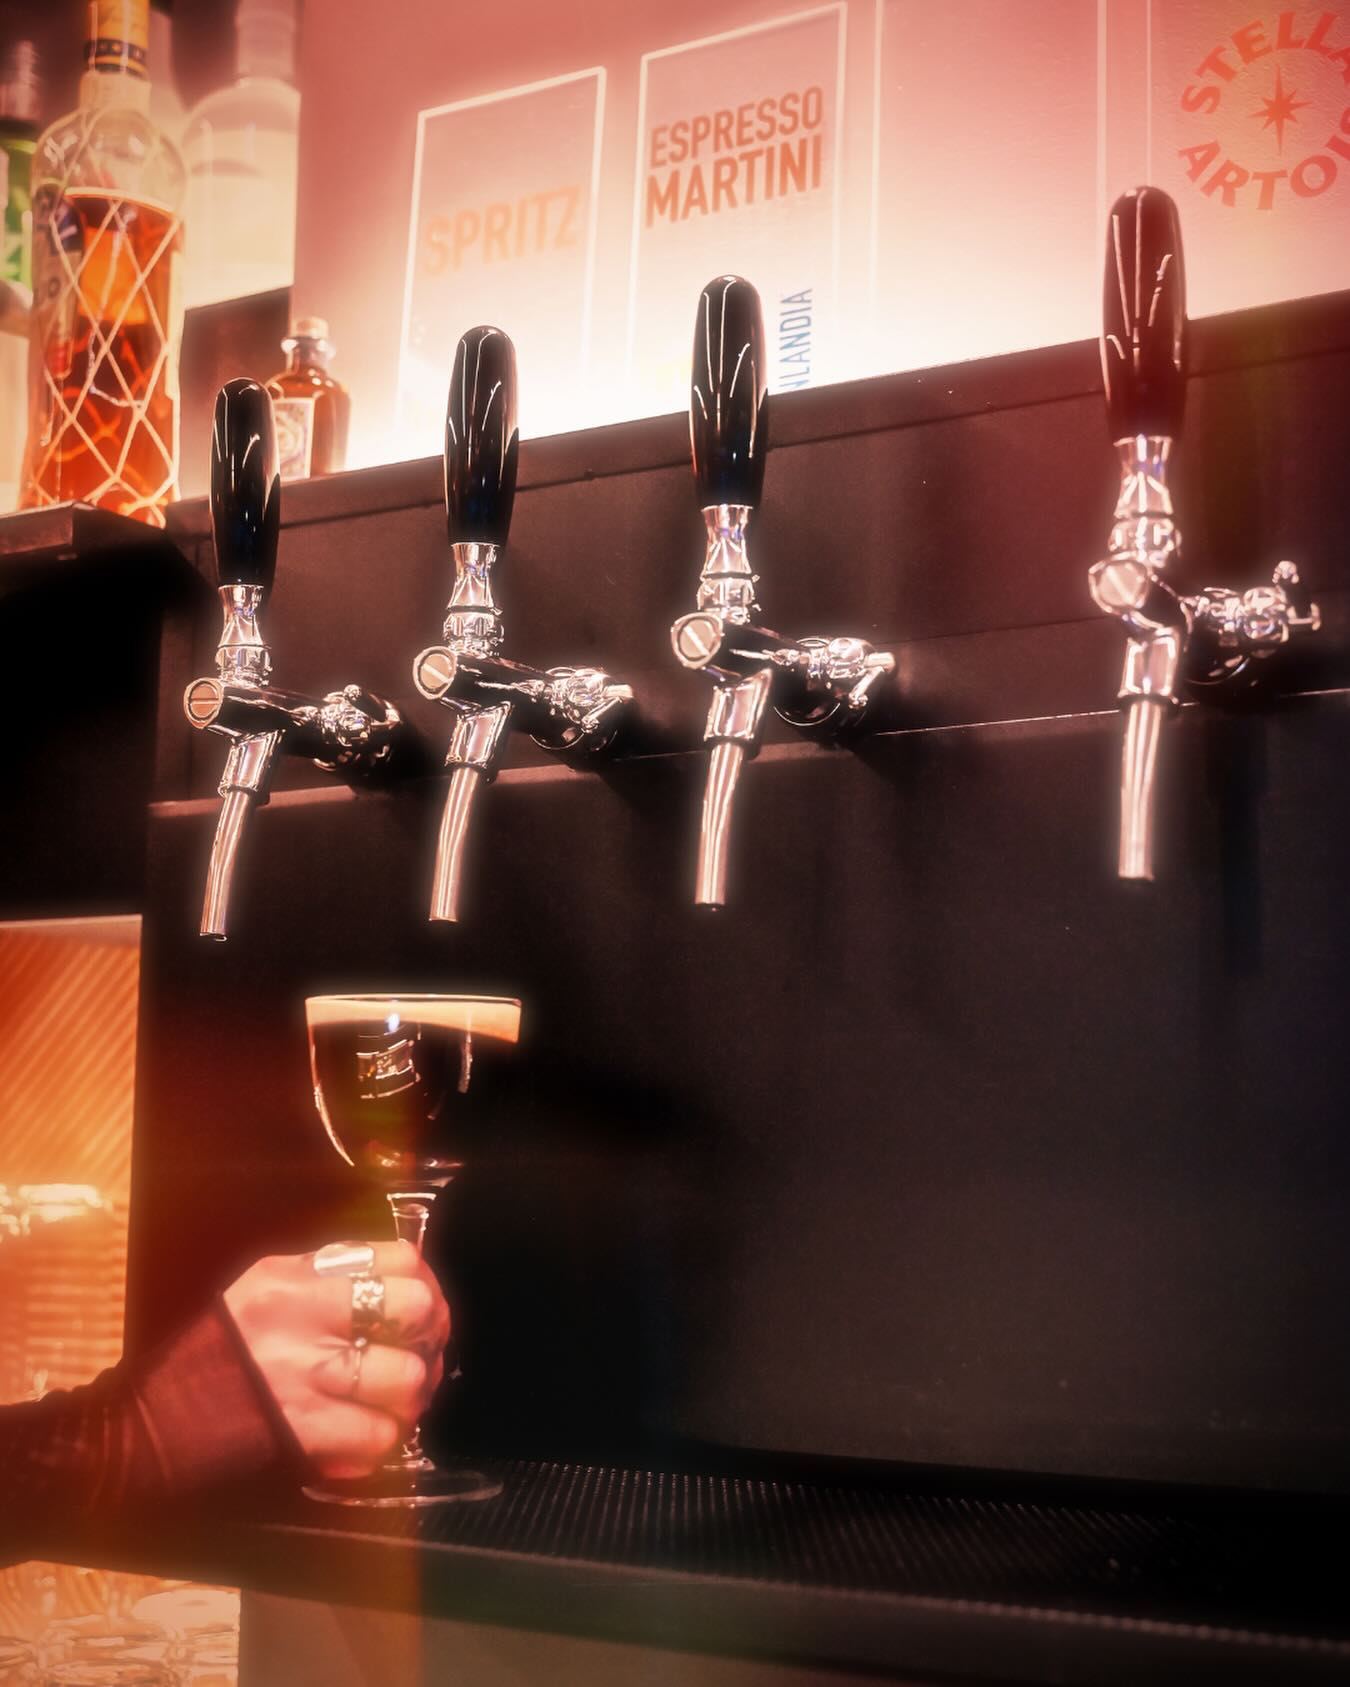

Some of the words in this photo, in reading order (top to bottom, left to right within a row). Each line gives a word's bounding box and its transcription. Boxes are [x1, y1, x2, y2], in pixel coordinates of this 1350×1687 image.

[649, 85, 824, 170] ESPRESSO
[1178, 107, 1350, 211] ARTOI
[645, 133, 822, 230] MARTINI
[424, 184, 583, 277] SPRITZ
